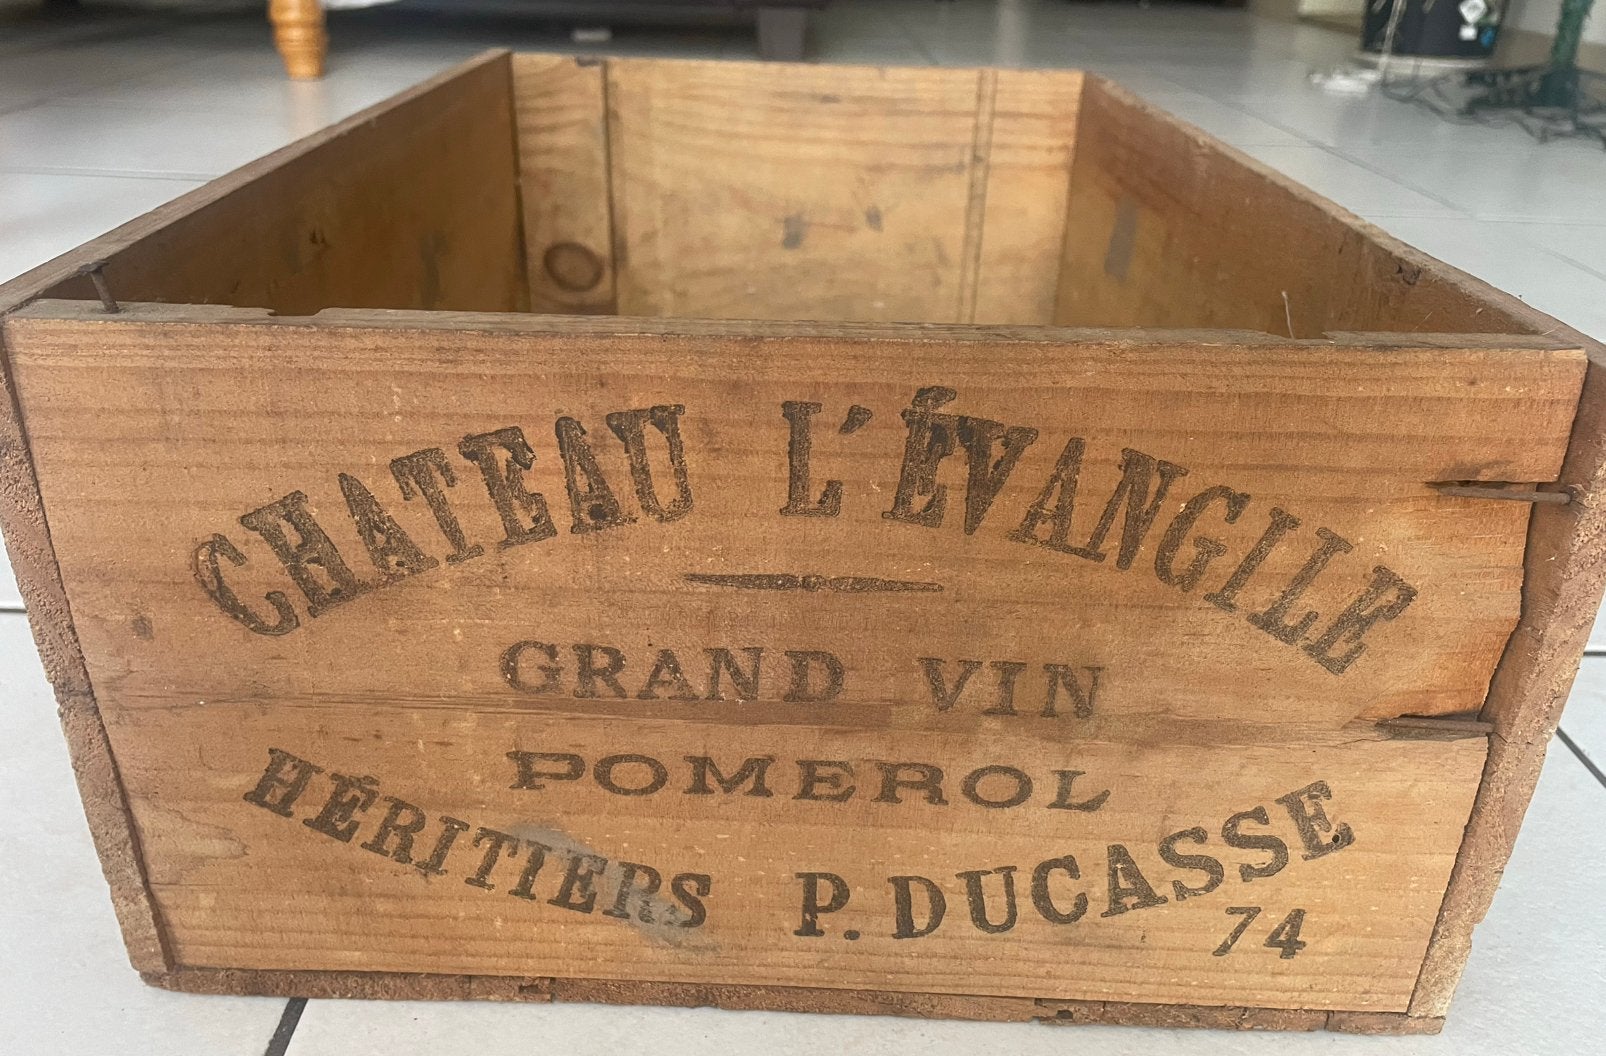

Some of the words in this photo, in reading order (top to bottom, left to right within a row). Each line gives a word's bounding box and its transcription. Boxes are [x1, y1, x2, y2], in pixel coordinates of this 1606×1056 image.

[192, 404, 694, 636] CHATEAU
[501, 640, 845, 703] GRAND
[917, 657, 1105, 719] VIN
[506, 750, 1111, 812] POMEROL
[1212, 906, 1307, 960] 74
